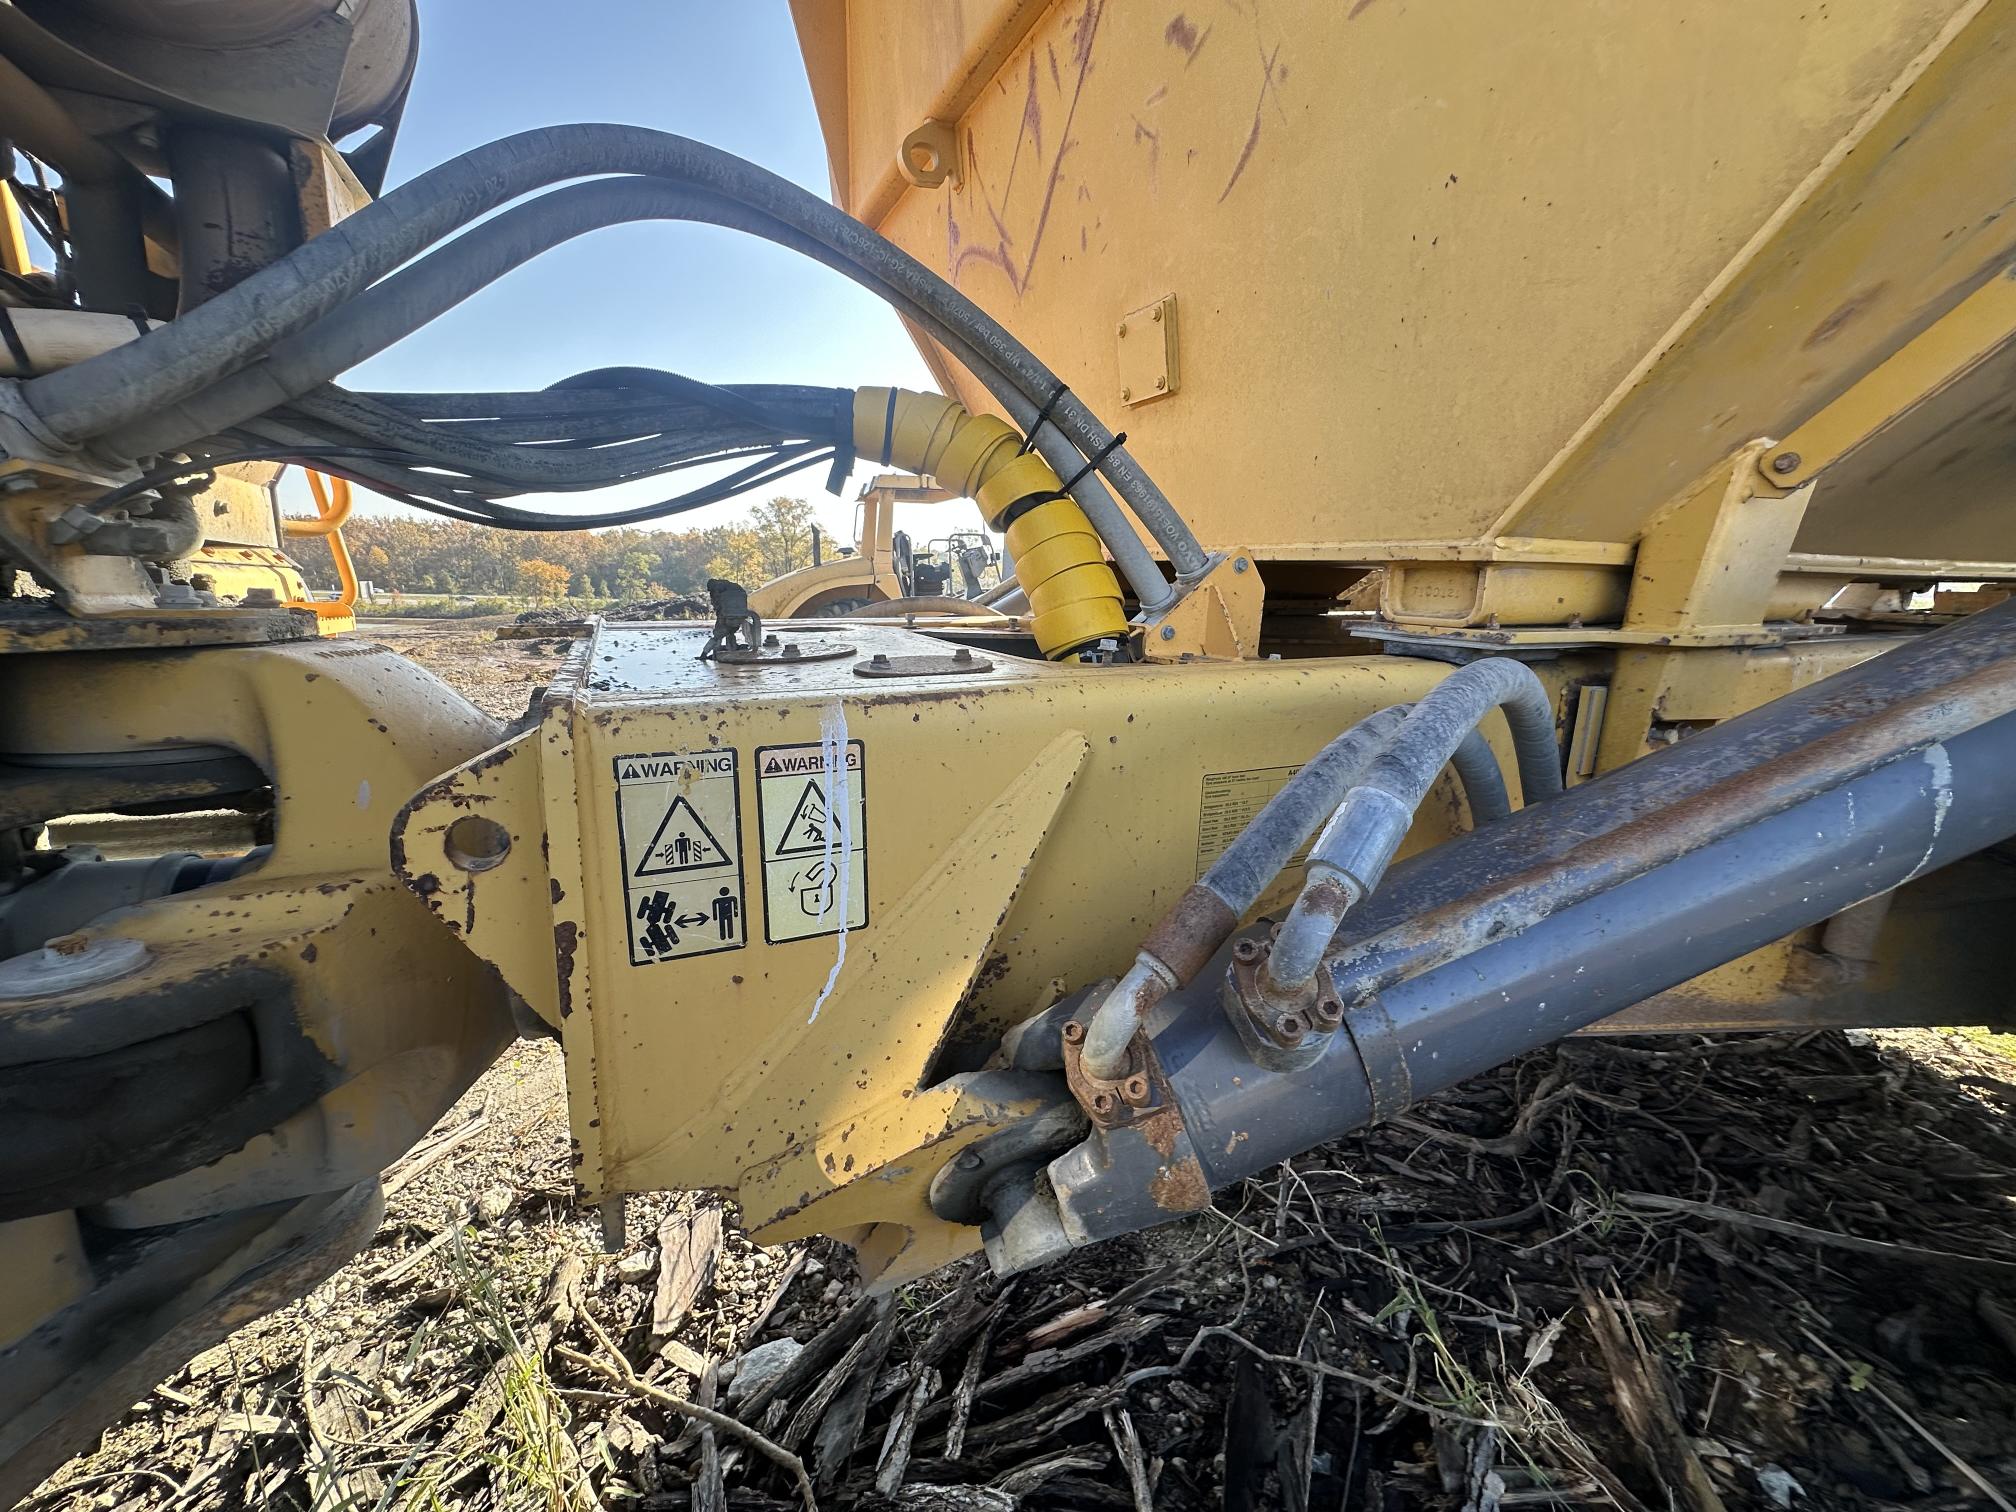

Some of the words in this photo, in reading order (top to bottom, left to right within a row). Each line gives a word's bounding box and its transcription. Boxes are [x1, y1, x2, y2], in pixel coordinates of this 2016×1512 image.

[972, 321, 991, 339] bar
[988, 334, 1008, 353] 350
[1004, 348, 1024, 368] WP
[1063, 405, 1077, 419] 31
[1074, 416, 1091, 433] DN
[1106, 450, 1121, 467] 85
[1117, 464, 1133, 480] EN
[640, 757, 732, 778] WARNING
